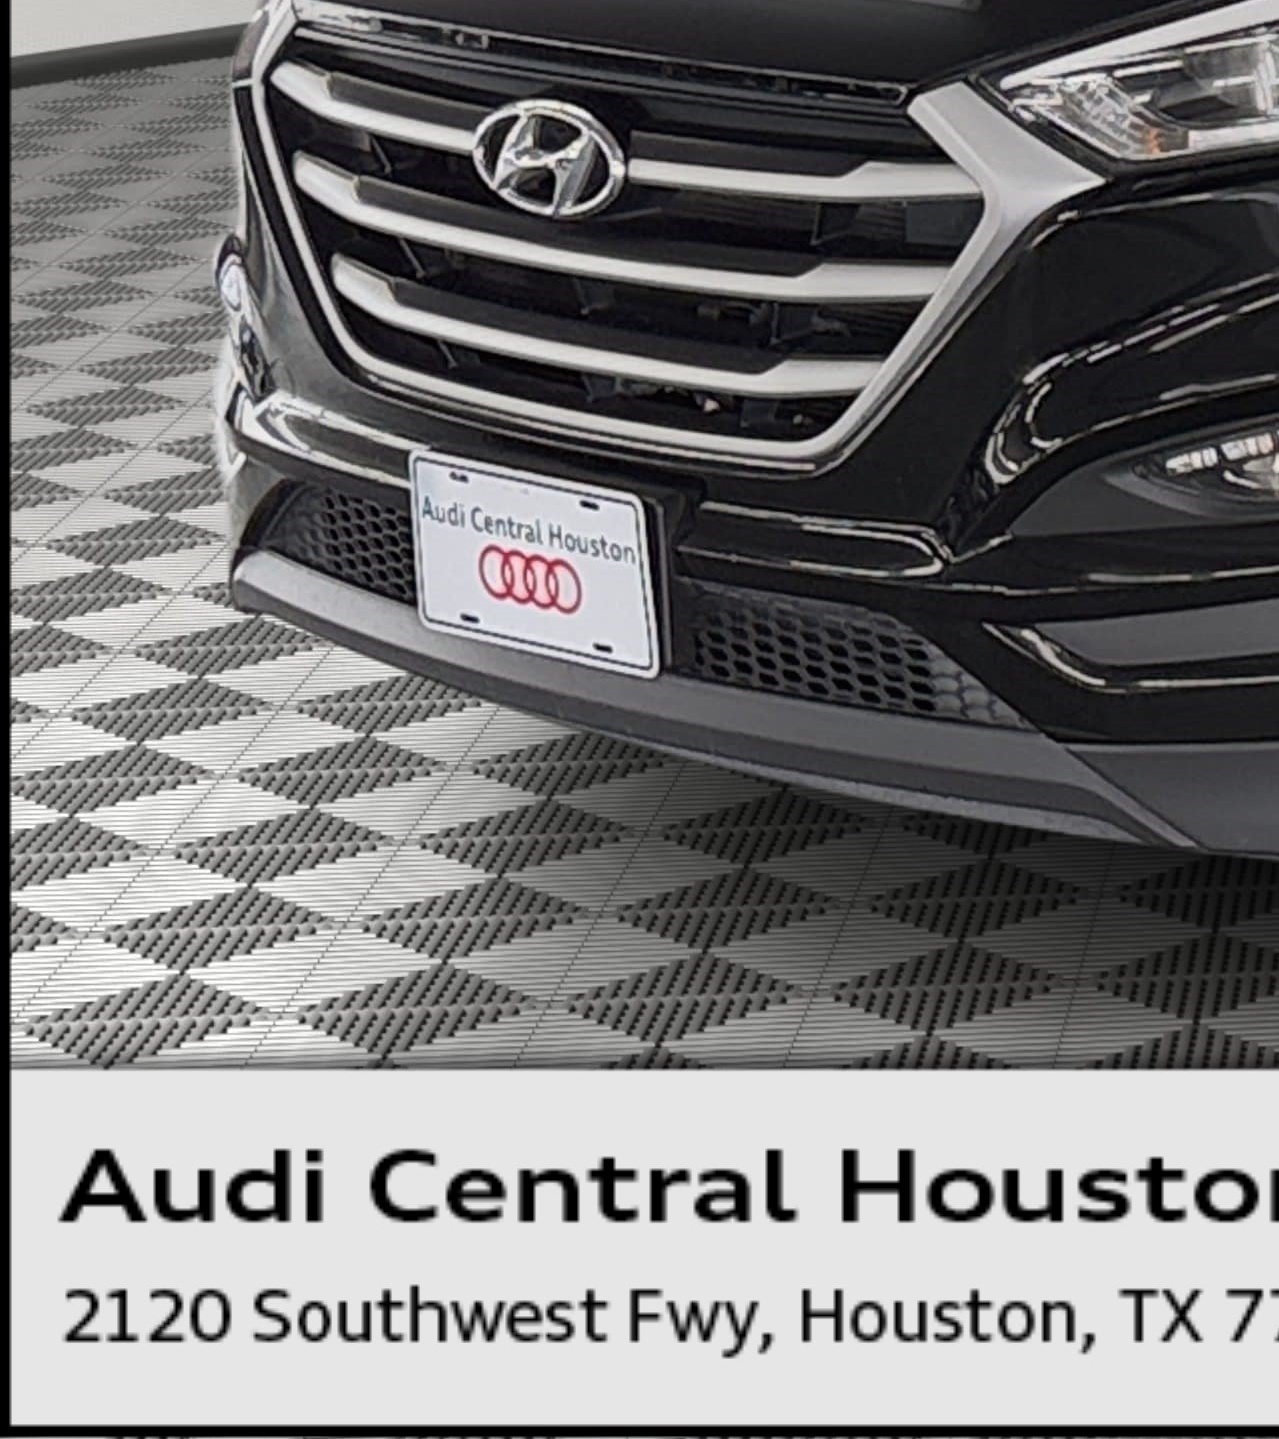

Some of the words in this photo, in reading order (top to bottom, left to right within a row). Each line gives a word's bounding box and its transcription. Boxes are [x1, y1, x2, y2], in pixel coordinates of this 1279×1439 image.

[421, 495, 466, 528] Audi
[470, 506, 544, 545] Central
[550, 522, 637, 565] Houston
